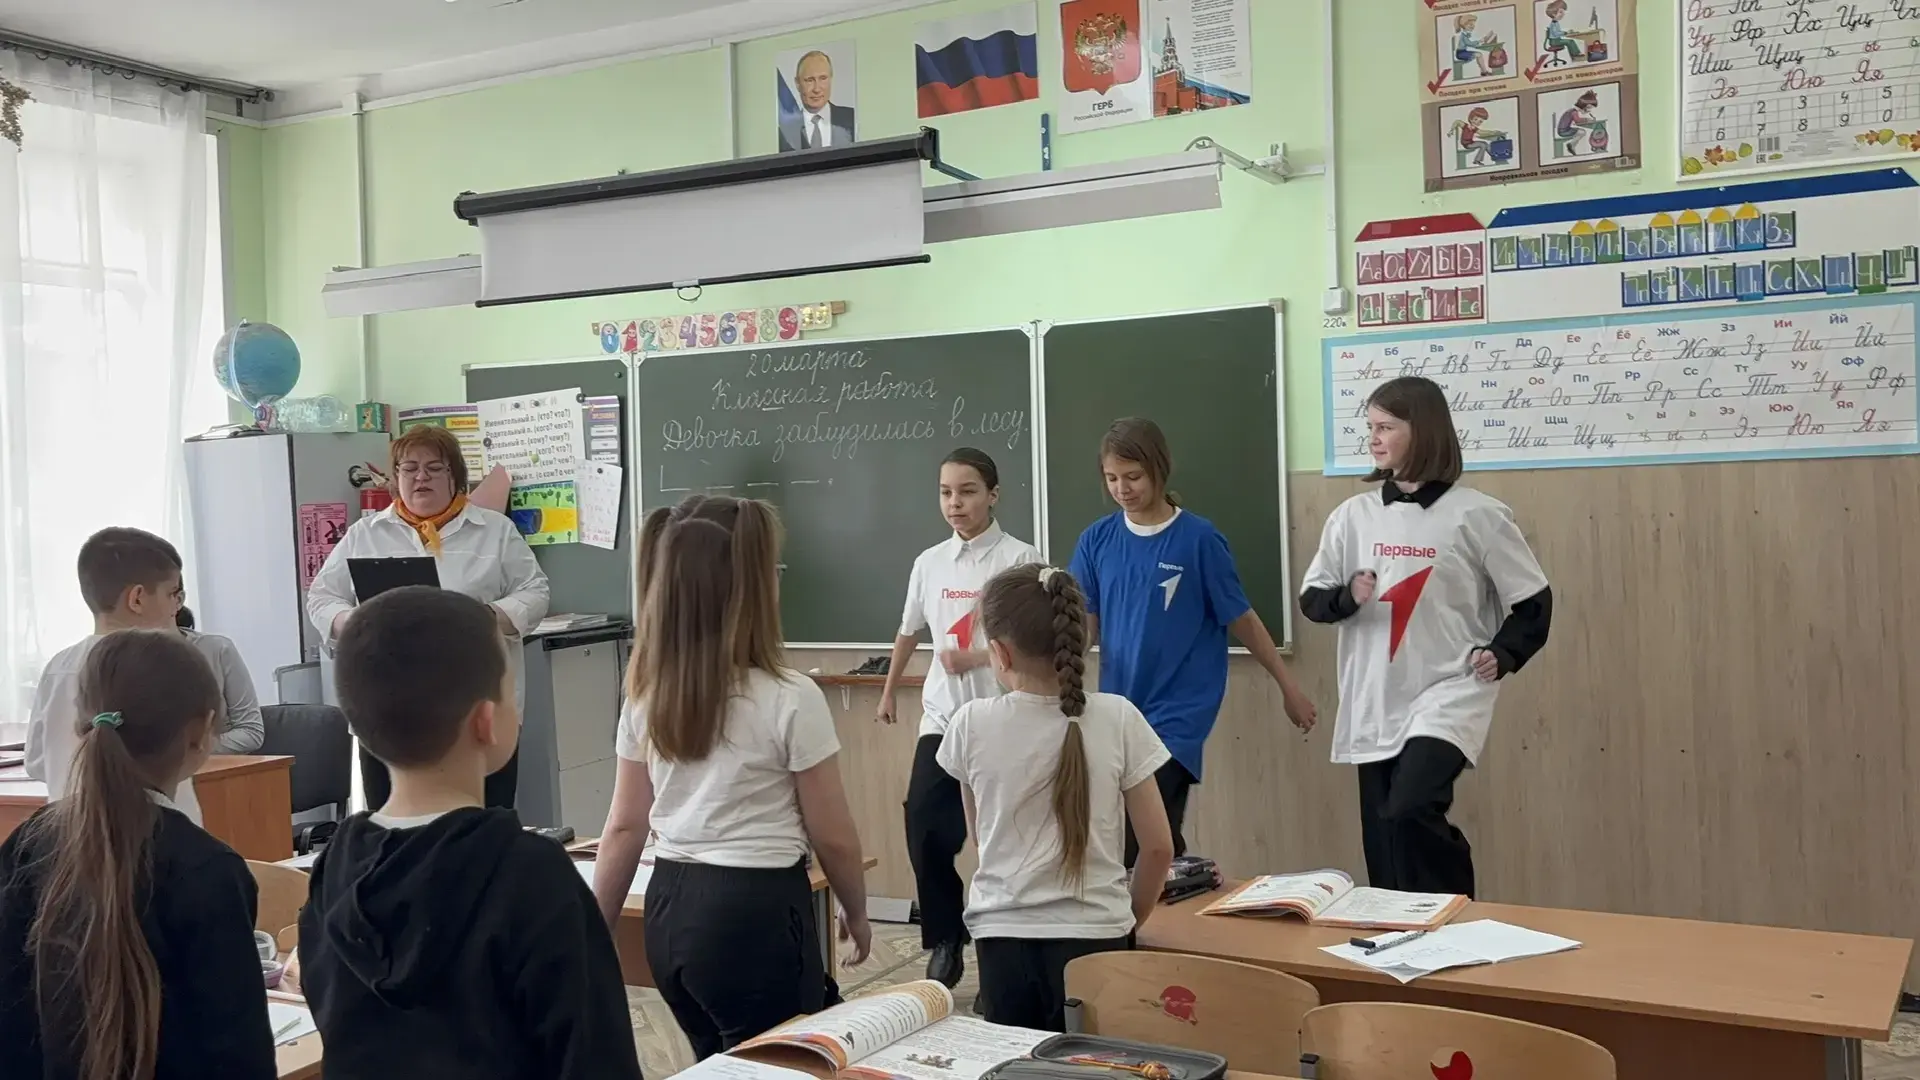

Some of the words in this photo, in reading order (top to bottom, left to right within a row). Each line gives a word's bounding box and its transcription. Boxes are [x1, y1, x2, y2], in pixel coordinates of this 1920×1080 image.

[1730, 19, 1766, 46] Фф
[1783, 11, 1824, 35] Хх
[1780, 68, 1825, 91] Юю
[1852, 59, 1884, 83] Яя
[1092, 100, 1114, 111] ГЕРБ
[1717, 106, 1725, 119] 1
[1757, 101, 1766, 114] 2
[1797, 95, 1807, 110] 3
[1840, 91, 1849, 105] 4
[1882, 86, 1893, 99] 5
[1716, 128, 1725, 141] 6
[1757, 124, 1766, 136] 7
[1798, 119, 1808, 132] 8
[1839, 114, 1849, 127] 9
[1882, 109, 1893, 123] 0
[601, 323, 620, 353] 0
[621, 321, 638, 352] 1
[639, 319, 658, 351] 2
[658, 318, 677, 349] 3
[679, 316, 697, 347] 4
[700, 314, 717, 346] 5
[719, 312, 738, 344] 6
[737, 311, 757, 342] 7
[760, 308, 778, 341] 8
[778, 307, 799, 340] 9
[1341, 351, 1355, 359] Аа
[1384, 346, 1399, 356] Бб
[1430, 344, 1444, 352] Вв
[1475, 341, 1486, 349] Гг
[1516, 338, 1532, 348] Дд
[1567, 334, 1581, 343] Ее
[1617, 329, 1631, 339] Ёё
[1657, 328, 1681, 336] Жж
[1721, 323, 1736, 332] Зз
[1774, 319, 1793, 329] Ии
[1829, 313, 1848, 324] Йй
[746, 353, 771, 377] 20
[774, 350, 868, 385] марта
[1341, 389, 1355, 397] Кк
[1481, 380, 1497, 388] Нн
[1529, 376, 1545, 385] Оо
[1573, 374, 1589, 383] Пп
[1625, 371, 1641, 381] Рр
[1683, 367, 1698, 376] Сс
[1735, 364, 1749, 373] Тт
[1791, 360, 1808, 370] Уу
[1841, 356, 1865, 367] Фф
[835, 371, 939, 413] работа
[484, 414, 529, 428] Именительный
[662, 416, 760, 451] Девочка
[772, 411, 935, 463] заблудилась
[948, 396, 965, 438] в
[1483, 419, 1505, 427] Шш
[1544, 416, 1568, 425] Щщ
[1719, 406, 1735, 415] Ээ
[1769, 403, 1794, 413] Юю
[1837, 400, 1853, 409] Яя
[486, 427, 525, 438] Родительный
[1158, 562, 1184, 571] Первые
[1372, 543, 1436, 560] Первые
